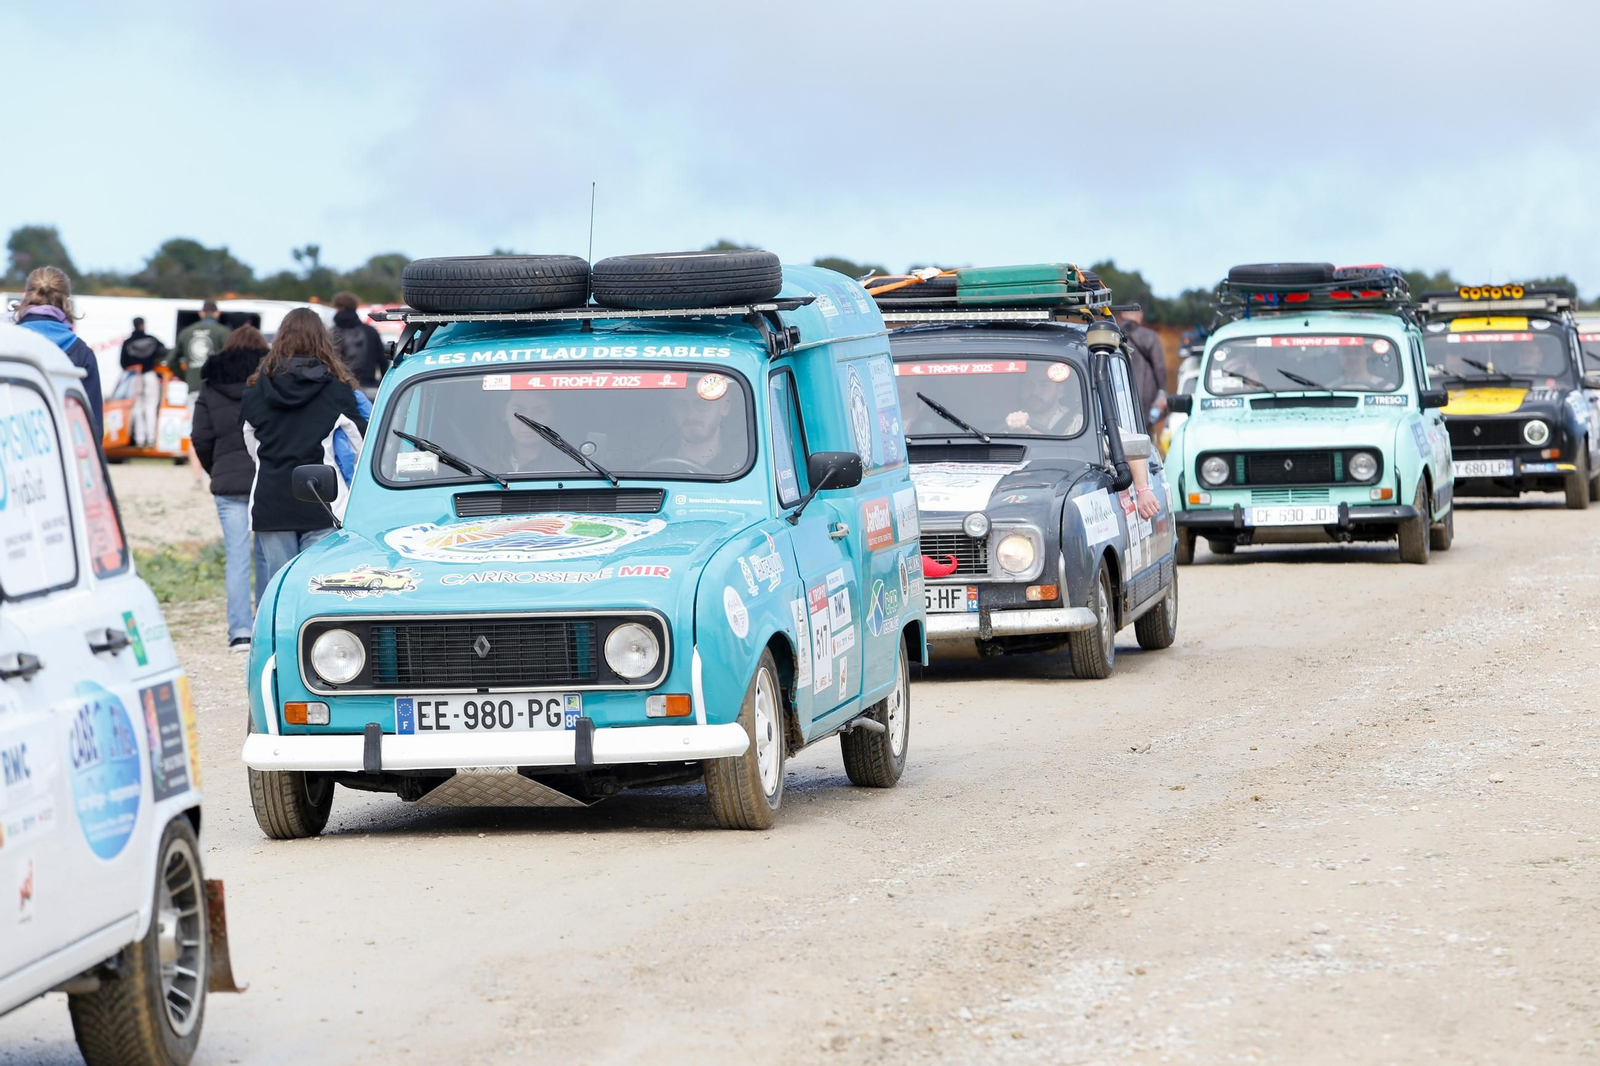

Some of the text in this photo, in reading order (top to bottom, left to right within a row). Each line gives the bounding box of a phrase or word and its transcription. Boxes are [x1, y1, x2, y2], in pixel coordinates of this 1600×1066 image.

[1292, 337, 1322, 346] TROPHY
[424, 346, 731, 366] LES MATT'LAU DES SABLES
[911, 363, 994, 374] 4L TROPHY 2025
[528, 376, 641, 388] 4L TROPHY 2025
[865, 502, 891, 533] Jardiland
[440, 565, 671, 586] CARROSSERIE MIR
[833, 591, 846, 619] RMC
[968, 600, 978, 609] 12
[816, 624, 828, 661] 517
[417, 698, 562, 731] EE-980-PG
[402, 721, 409, 730] F
[1, 741, 32, 787] RMC
